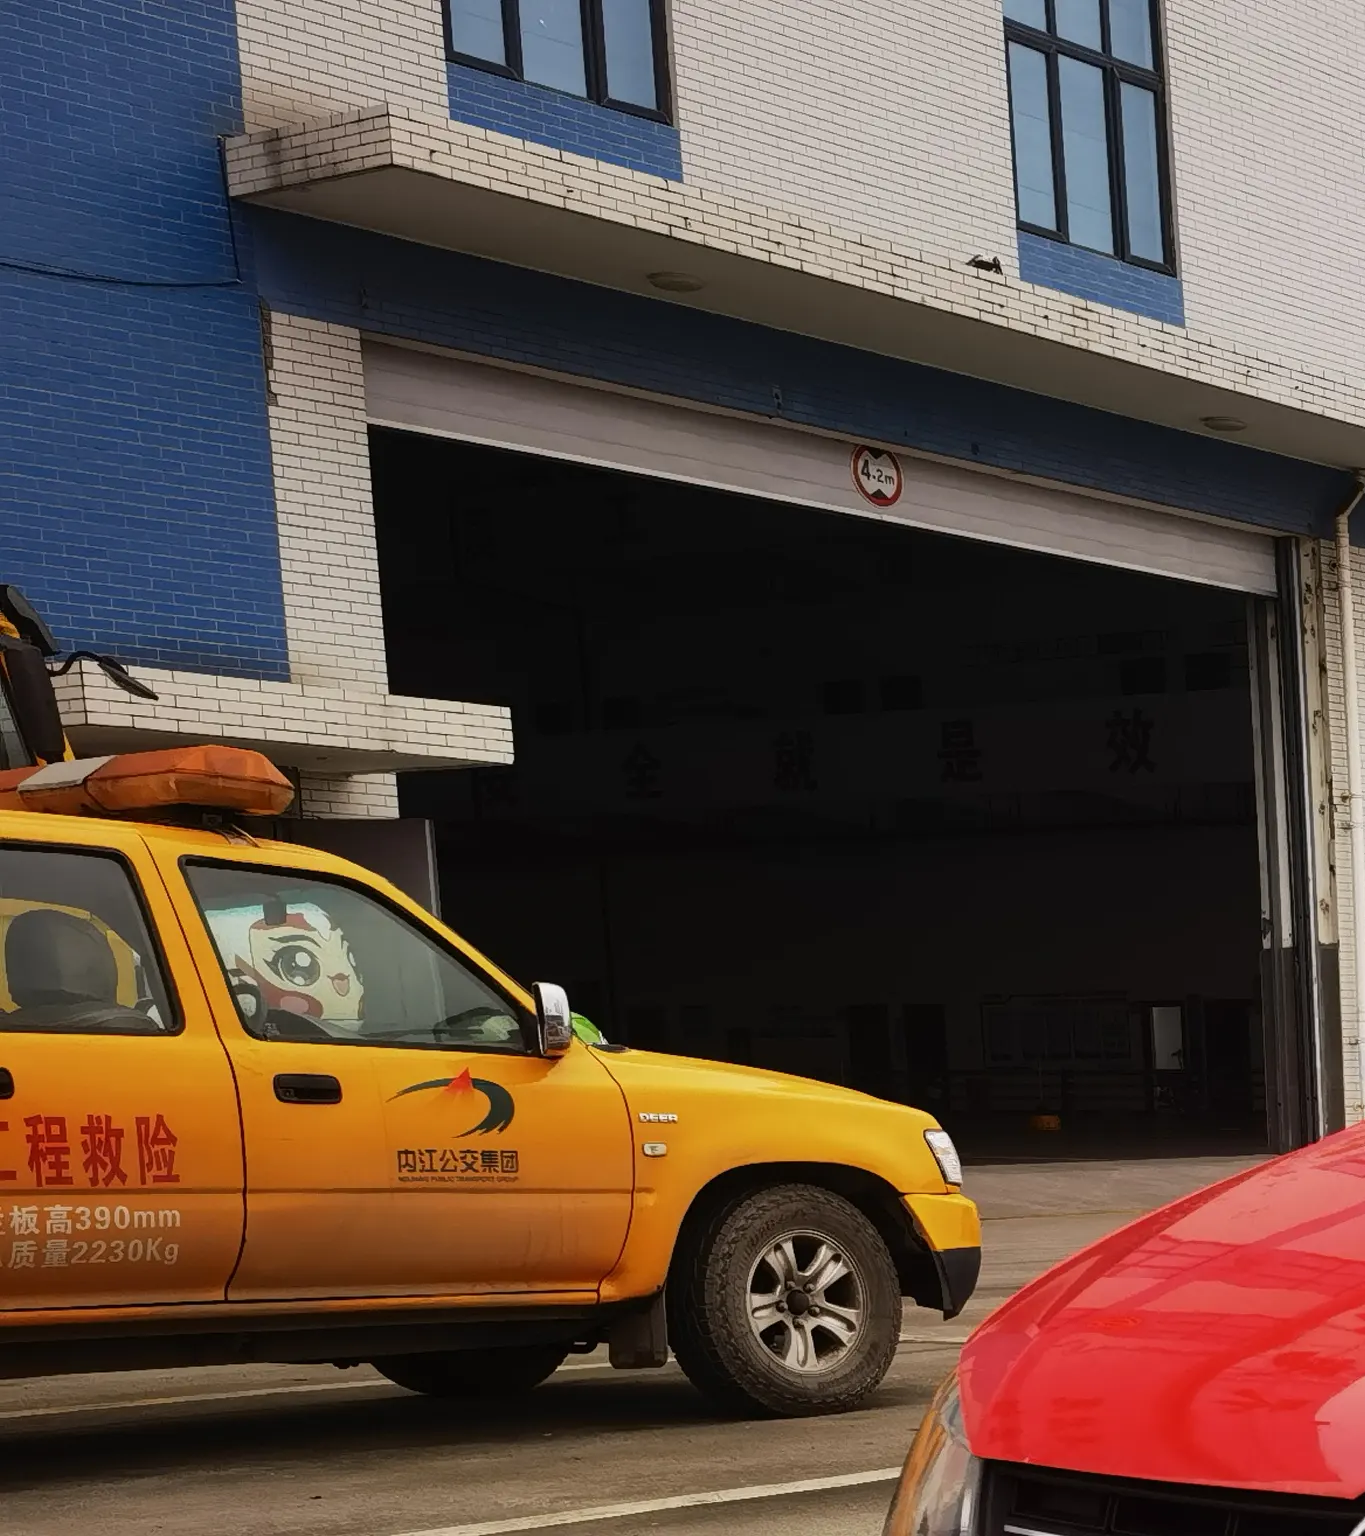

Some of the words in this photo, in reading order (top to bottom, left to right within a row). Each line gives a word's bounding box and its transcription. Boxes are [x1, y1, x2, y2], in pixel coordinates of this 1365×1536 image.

[861, 459, 895, 486] 4.2m
[638, 1112, 678, 1124] DEER
[397, 1149, 519, 1173] 内江公交集团
[0, 1204, 181, 1235] 板高390mm
[0, 1237, 180, 1269] 质量2230Kg
